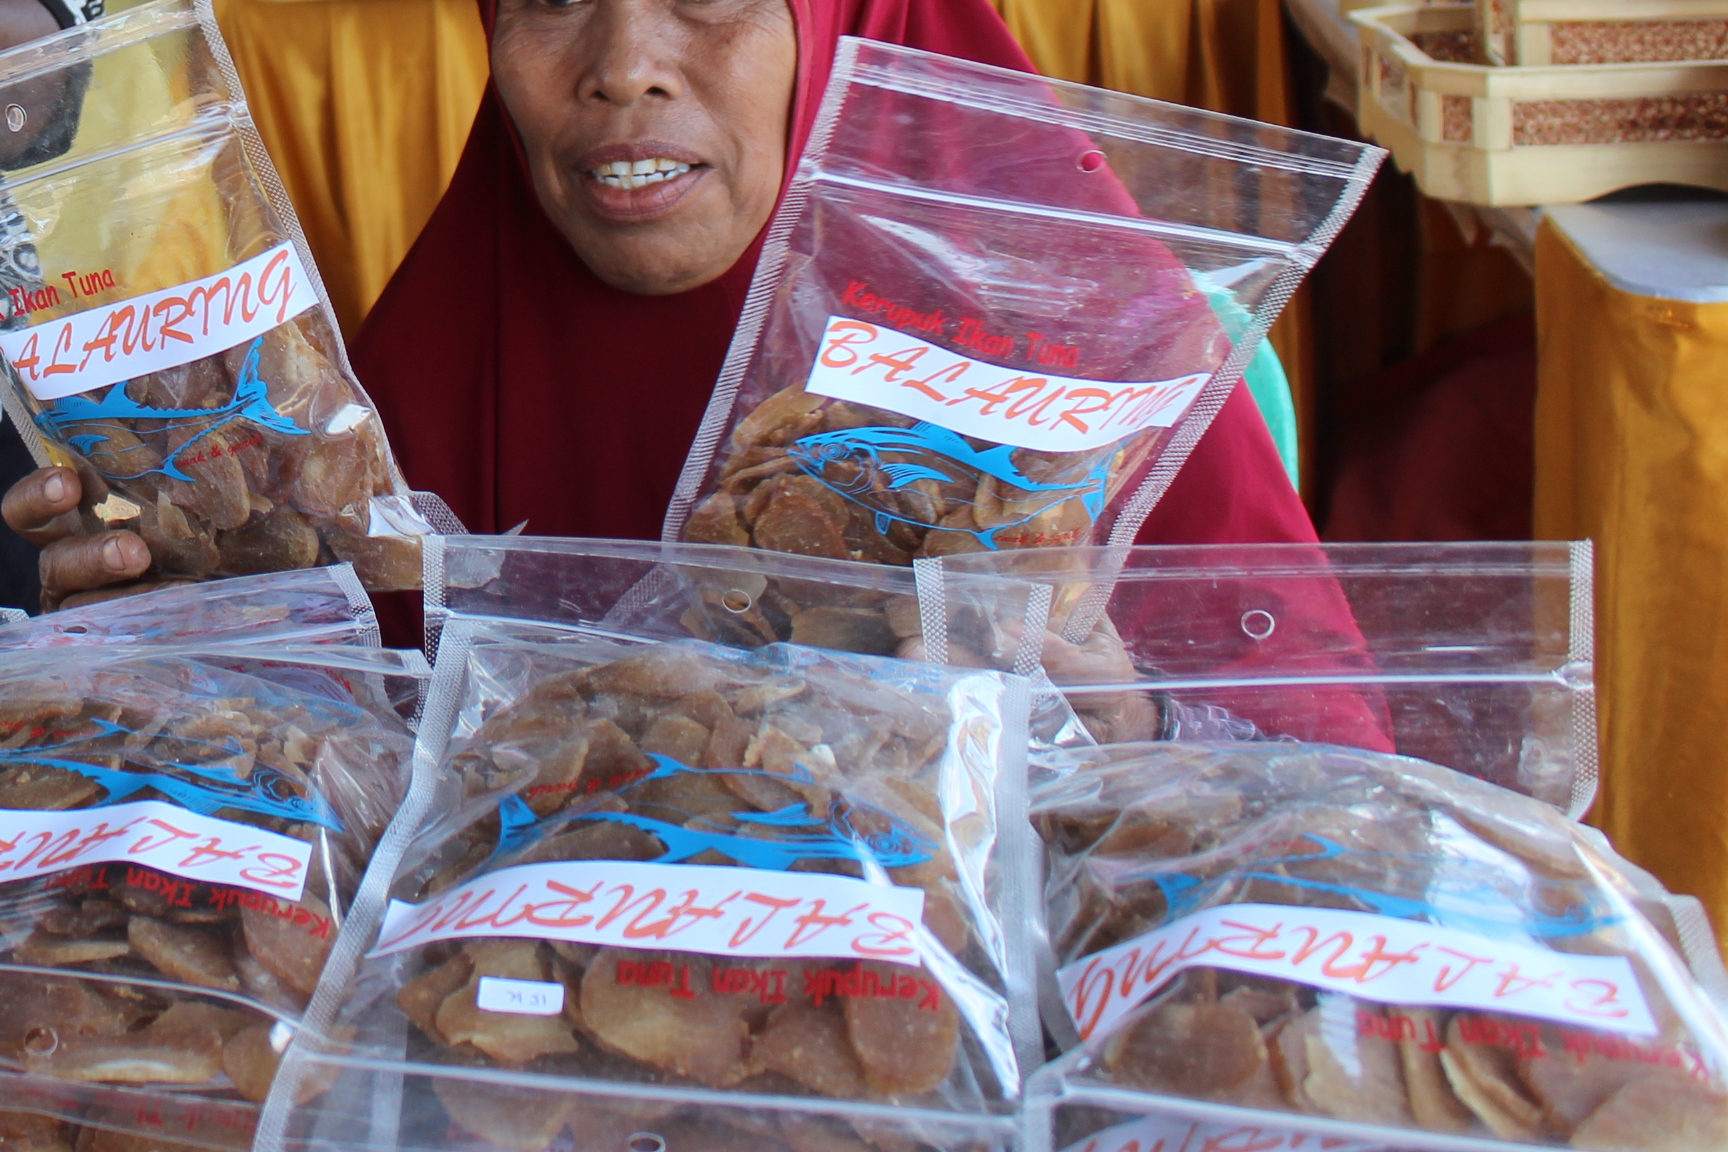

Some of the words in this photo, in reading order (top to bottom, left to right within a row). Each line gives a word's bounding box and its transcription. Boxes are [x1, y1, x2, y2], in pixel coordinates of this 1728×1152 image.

[8, 284, 60, 318] Ikan
[62, 269, 116, 299] Tuna
[841, 279, 948, 336] Kerupuk
[951, 316, 1015, 358] Ikan
[1024, 332, 1080, 368] Tuna
[126, 867, 193, 908] Ikan
[210, 885, 331, 939] Kerupuk
[618, 960, 696, 999] Tuna
[712, 961, 788, 1004] Ikan
[803, 963, 941, 1011] Kerupuk
[1071, 919, 1630, 1041] BALAURING
